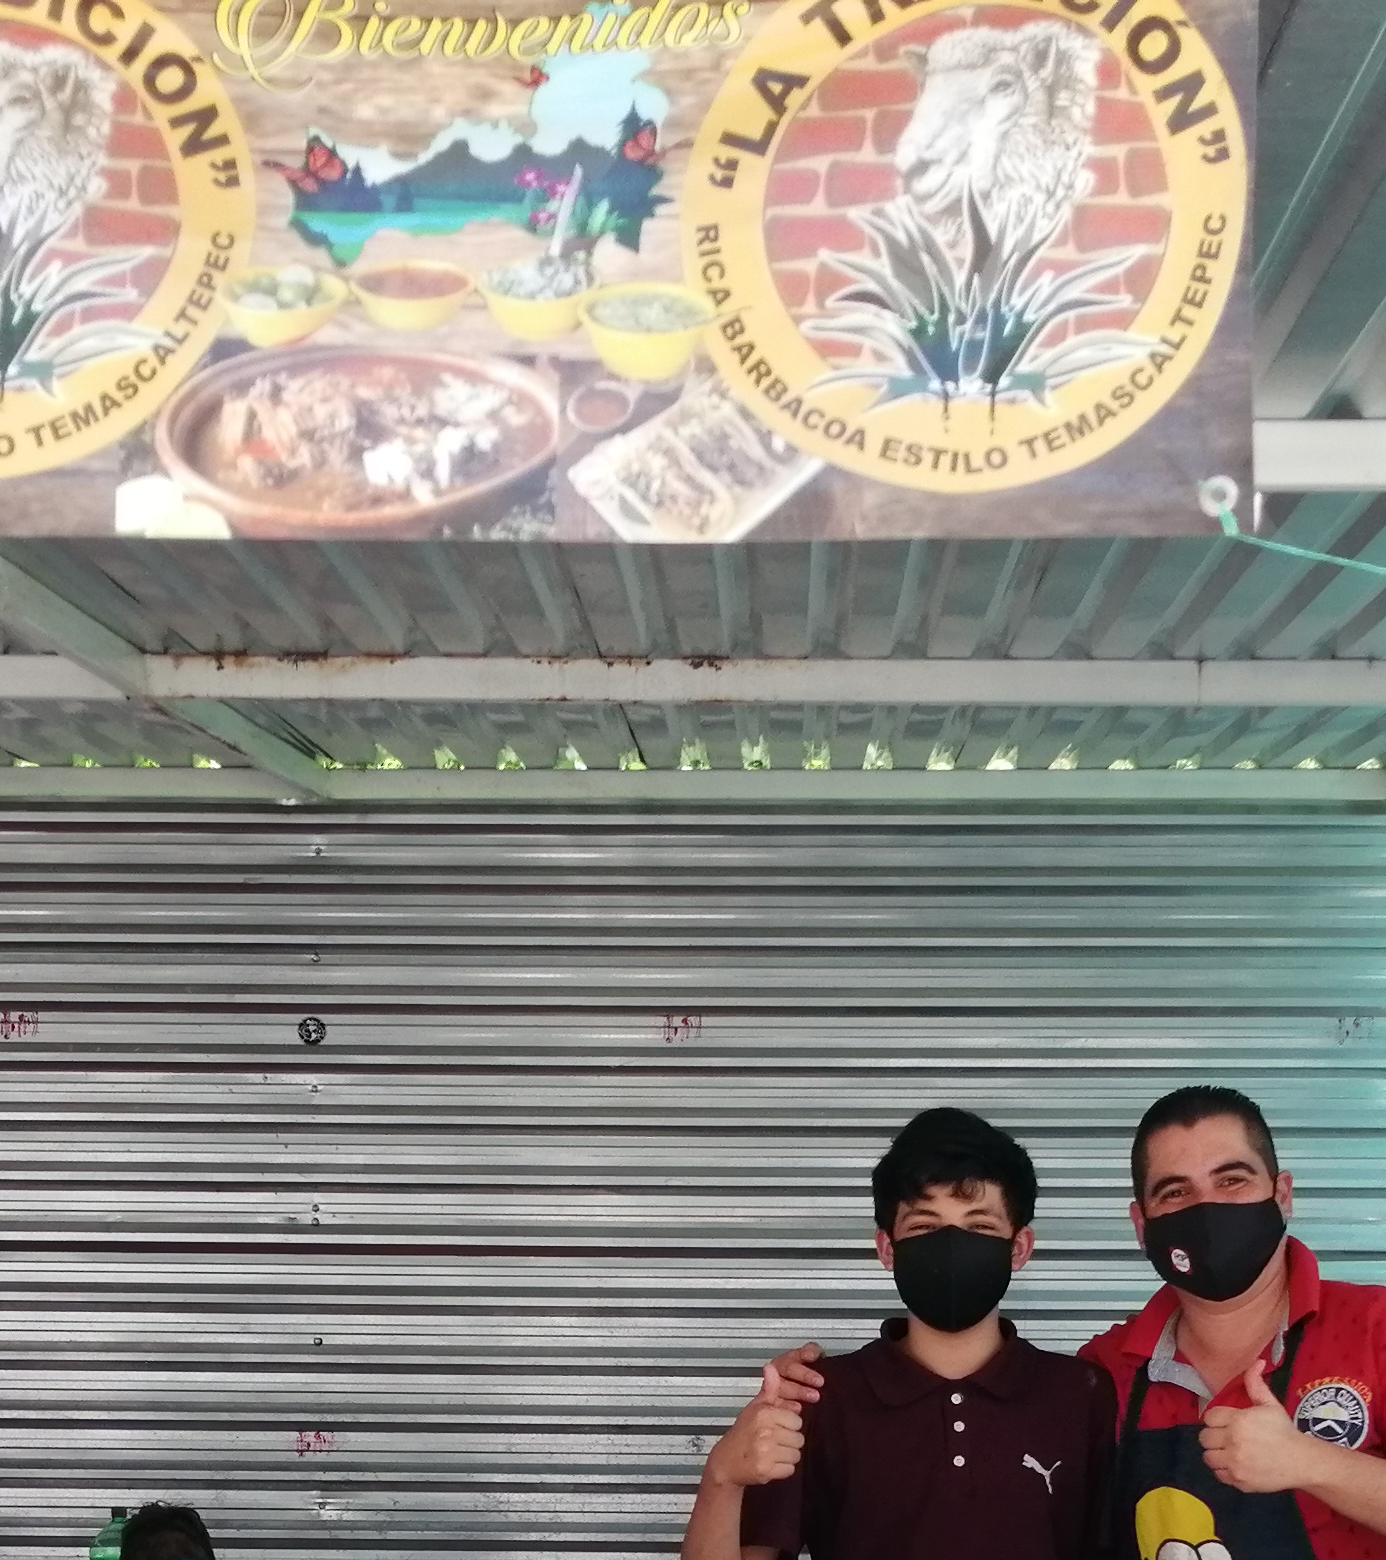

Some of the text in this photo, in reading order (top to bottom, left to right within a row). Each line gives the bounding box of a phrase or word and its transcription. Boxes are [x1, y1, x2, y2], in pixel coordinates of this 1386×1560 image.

[213, 0, 751, 92] Bienvenidos
[26, 230, 235, 448] TEMASCALTEPEC
[695, 212, 1227, 474] RICA BARBACOA ESTILO TEMASCALTEPEC
